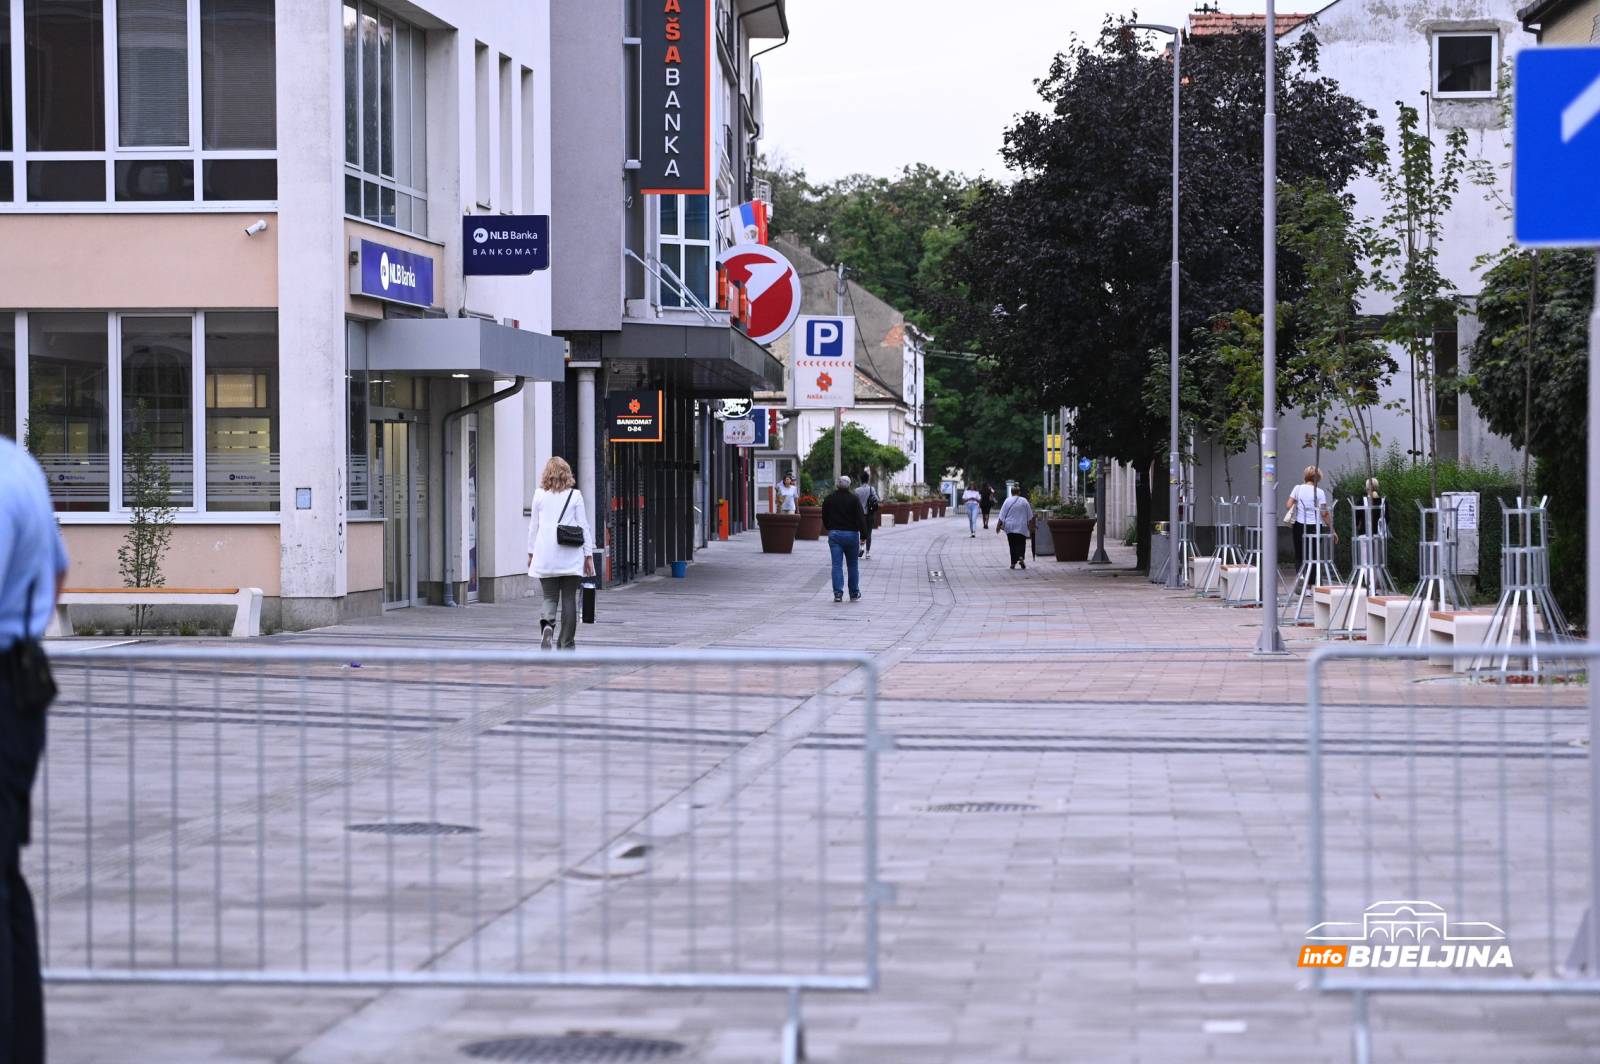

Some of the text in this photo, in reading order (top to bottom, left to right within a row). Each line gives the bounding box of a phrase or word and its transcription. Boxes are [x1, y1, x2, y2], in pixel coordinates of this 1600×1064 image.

[664, 67, 681, 178] BANKA
[490, 230, 538, 240] NLB Banka
[472, 248, 538, 256] BANKOMAT
[389, 262, 416, 288] NLB Banka
[813, 322, 839, 356] P
